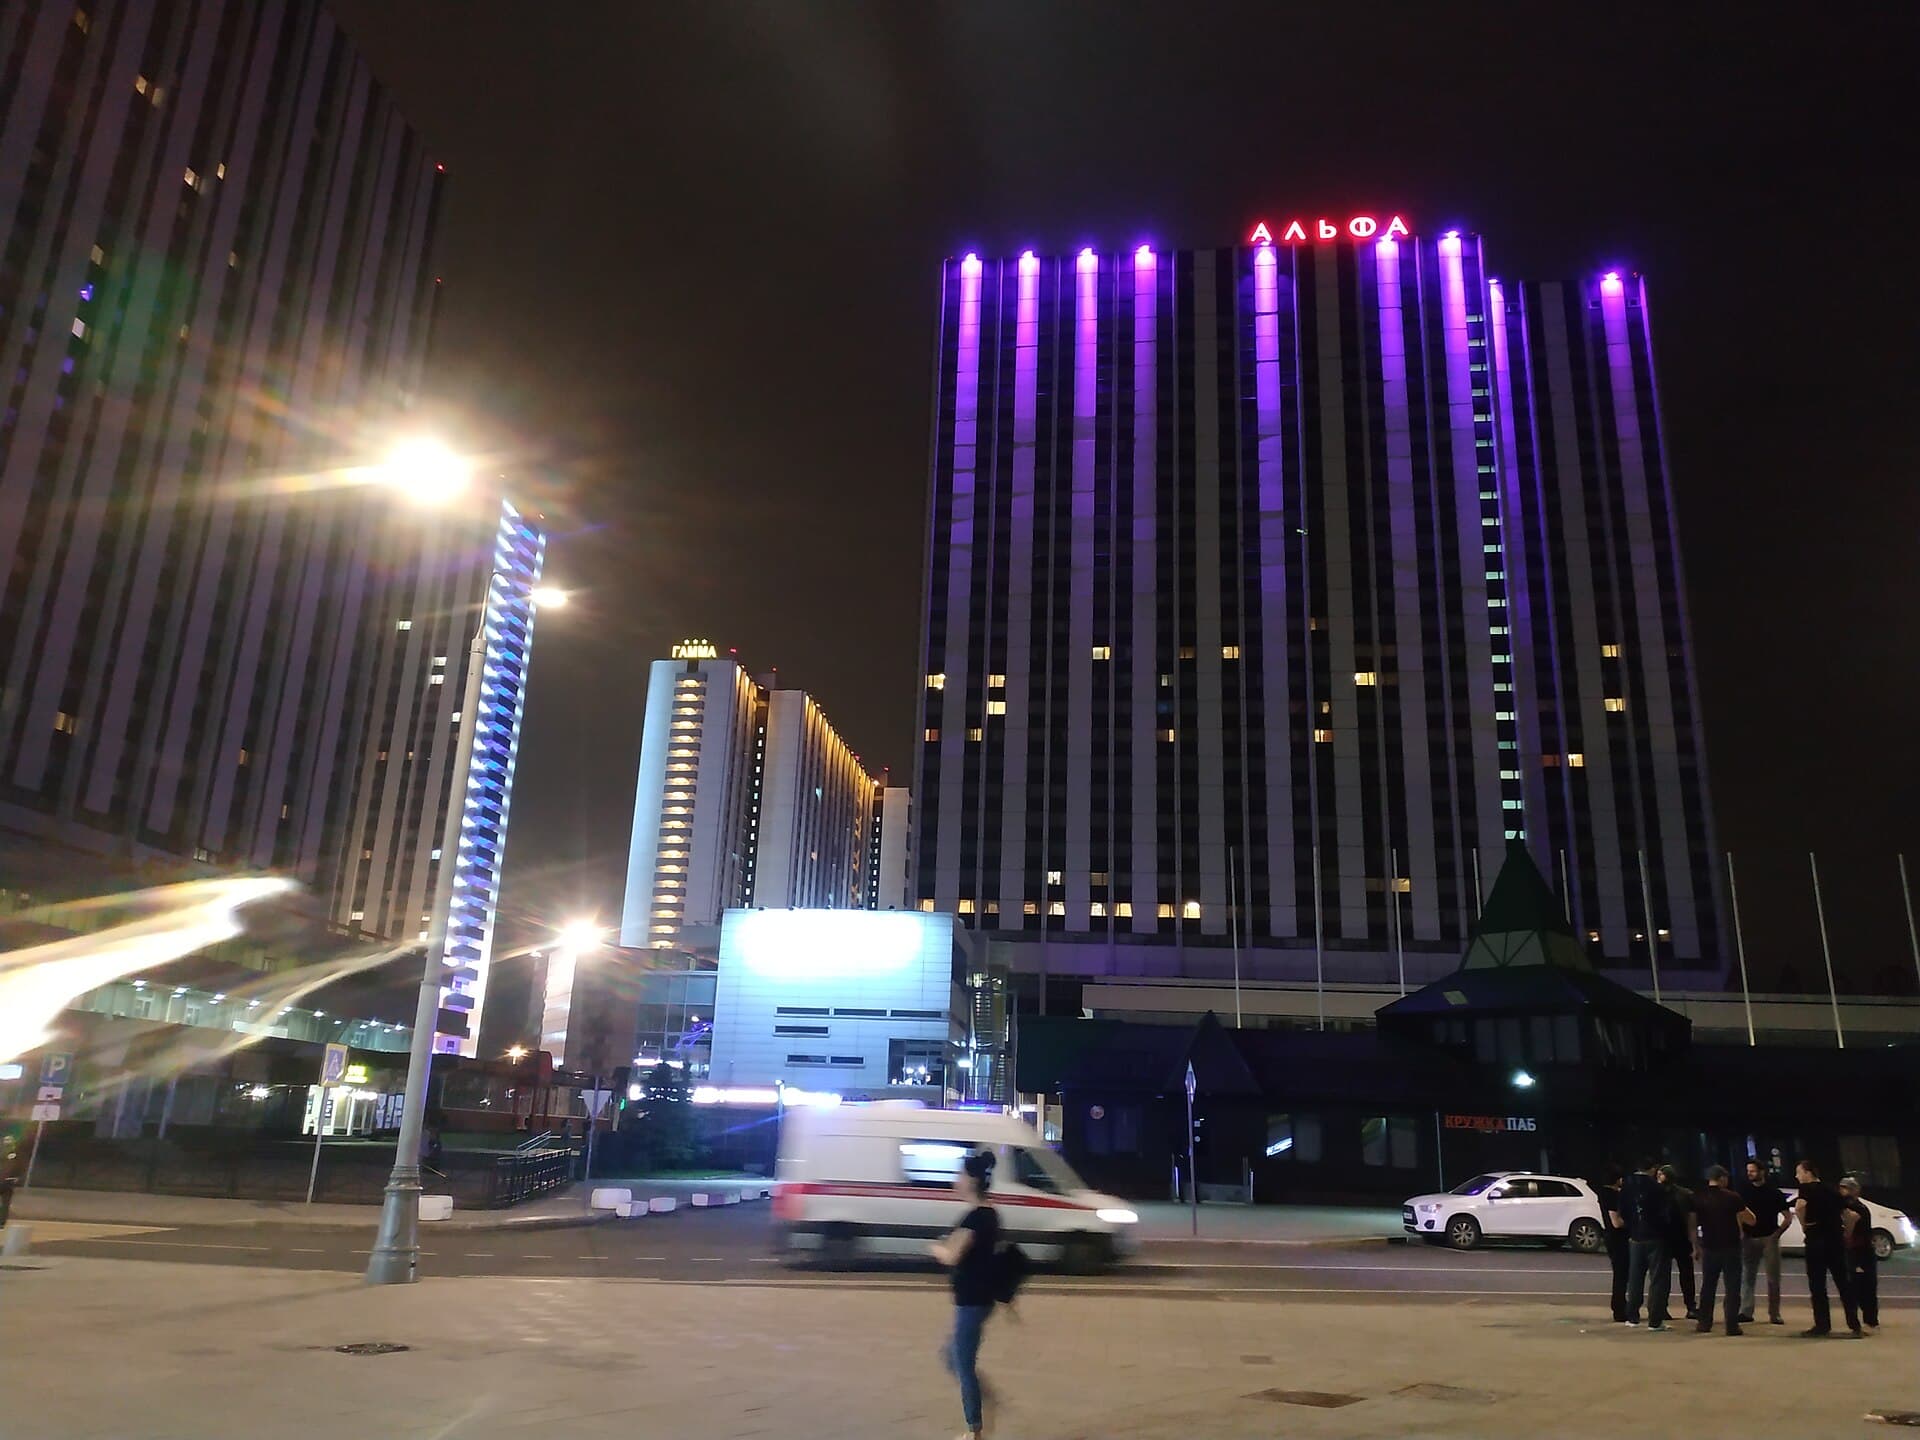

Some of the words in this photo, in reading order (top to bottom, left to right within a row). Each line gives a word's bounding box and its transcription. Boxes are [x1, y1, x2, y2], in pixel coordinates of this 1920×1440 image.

[1250, 215, 1409, 242] АЛЬФА
[671, 645, 717, 659] ГАММА
[48, 1056, 66, 1078] P
[1507, 1117, 1537, 1132] ПАБ
